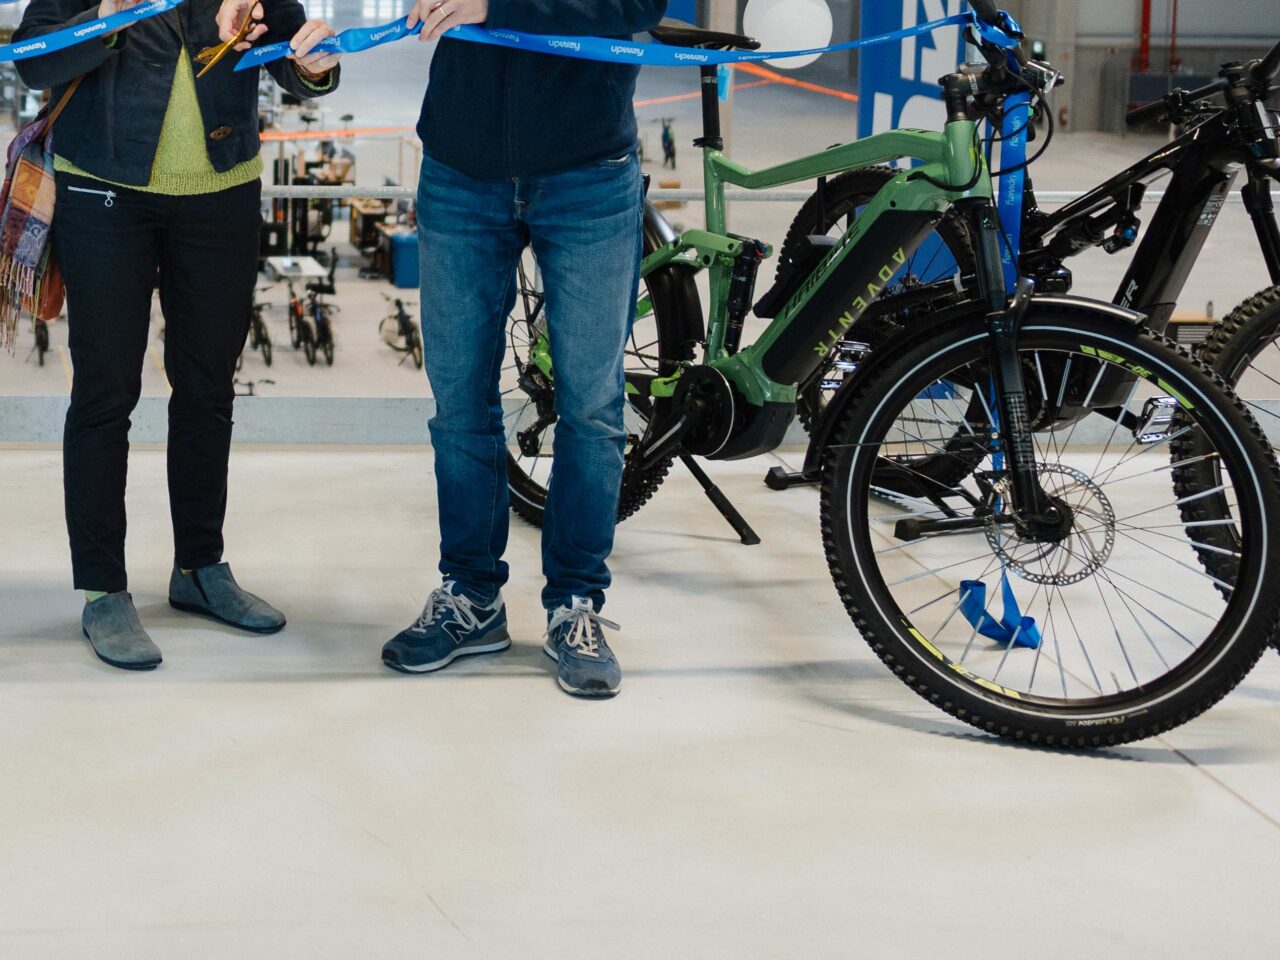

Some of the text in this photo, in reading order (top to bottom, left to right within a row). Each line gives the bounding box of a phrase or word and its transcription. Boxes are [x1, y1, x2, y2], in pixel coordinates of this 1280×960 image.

[12, 41, 47, 55] upway
[74, 22, 107, 37] upway
[548, 40, 581, 52] upway
[610, 45, 645, 57] upway
[674, 51, 709, 62] upway
[814, 247, 907, 357] ADVENTR
